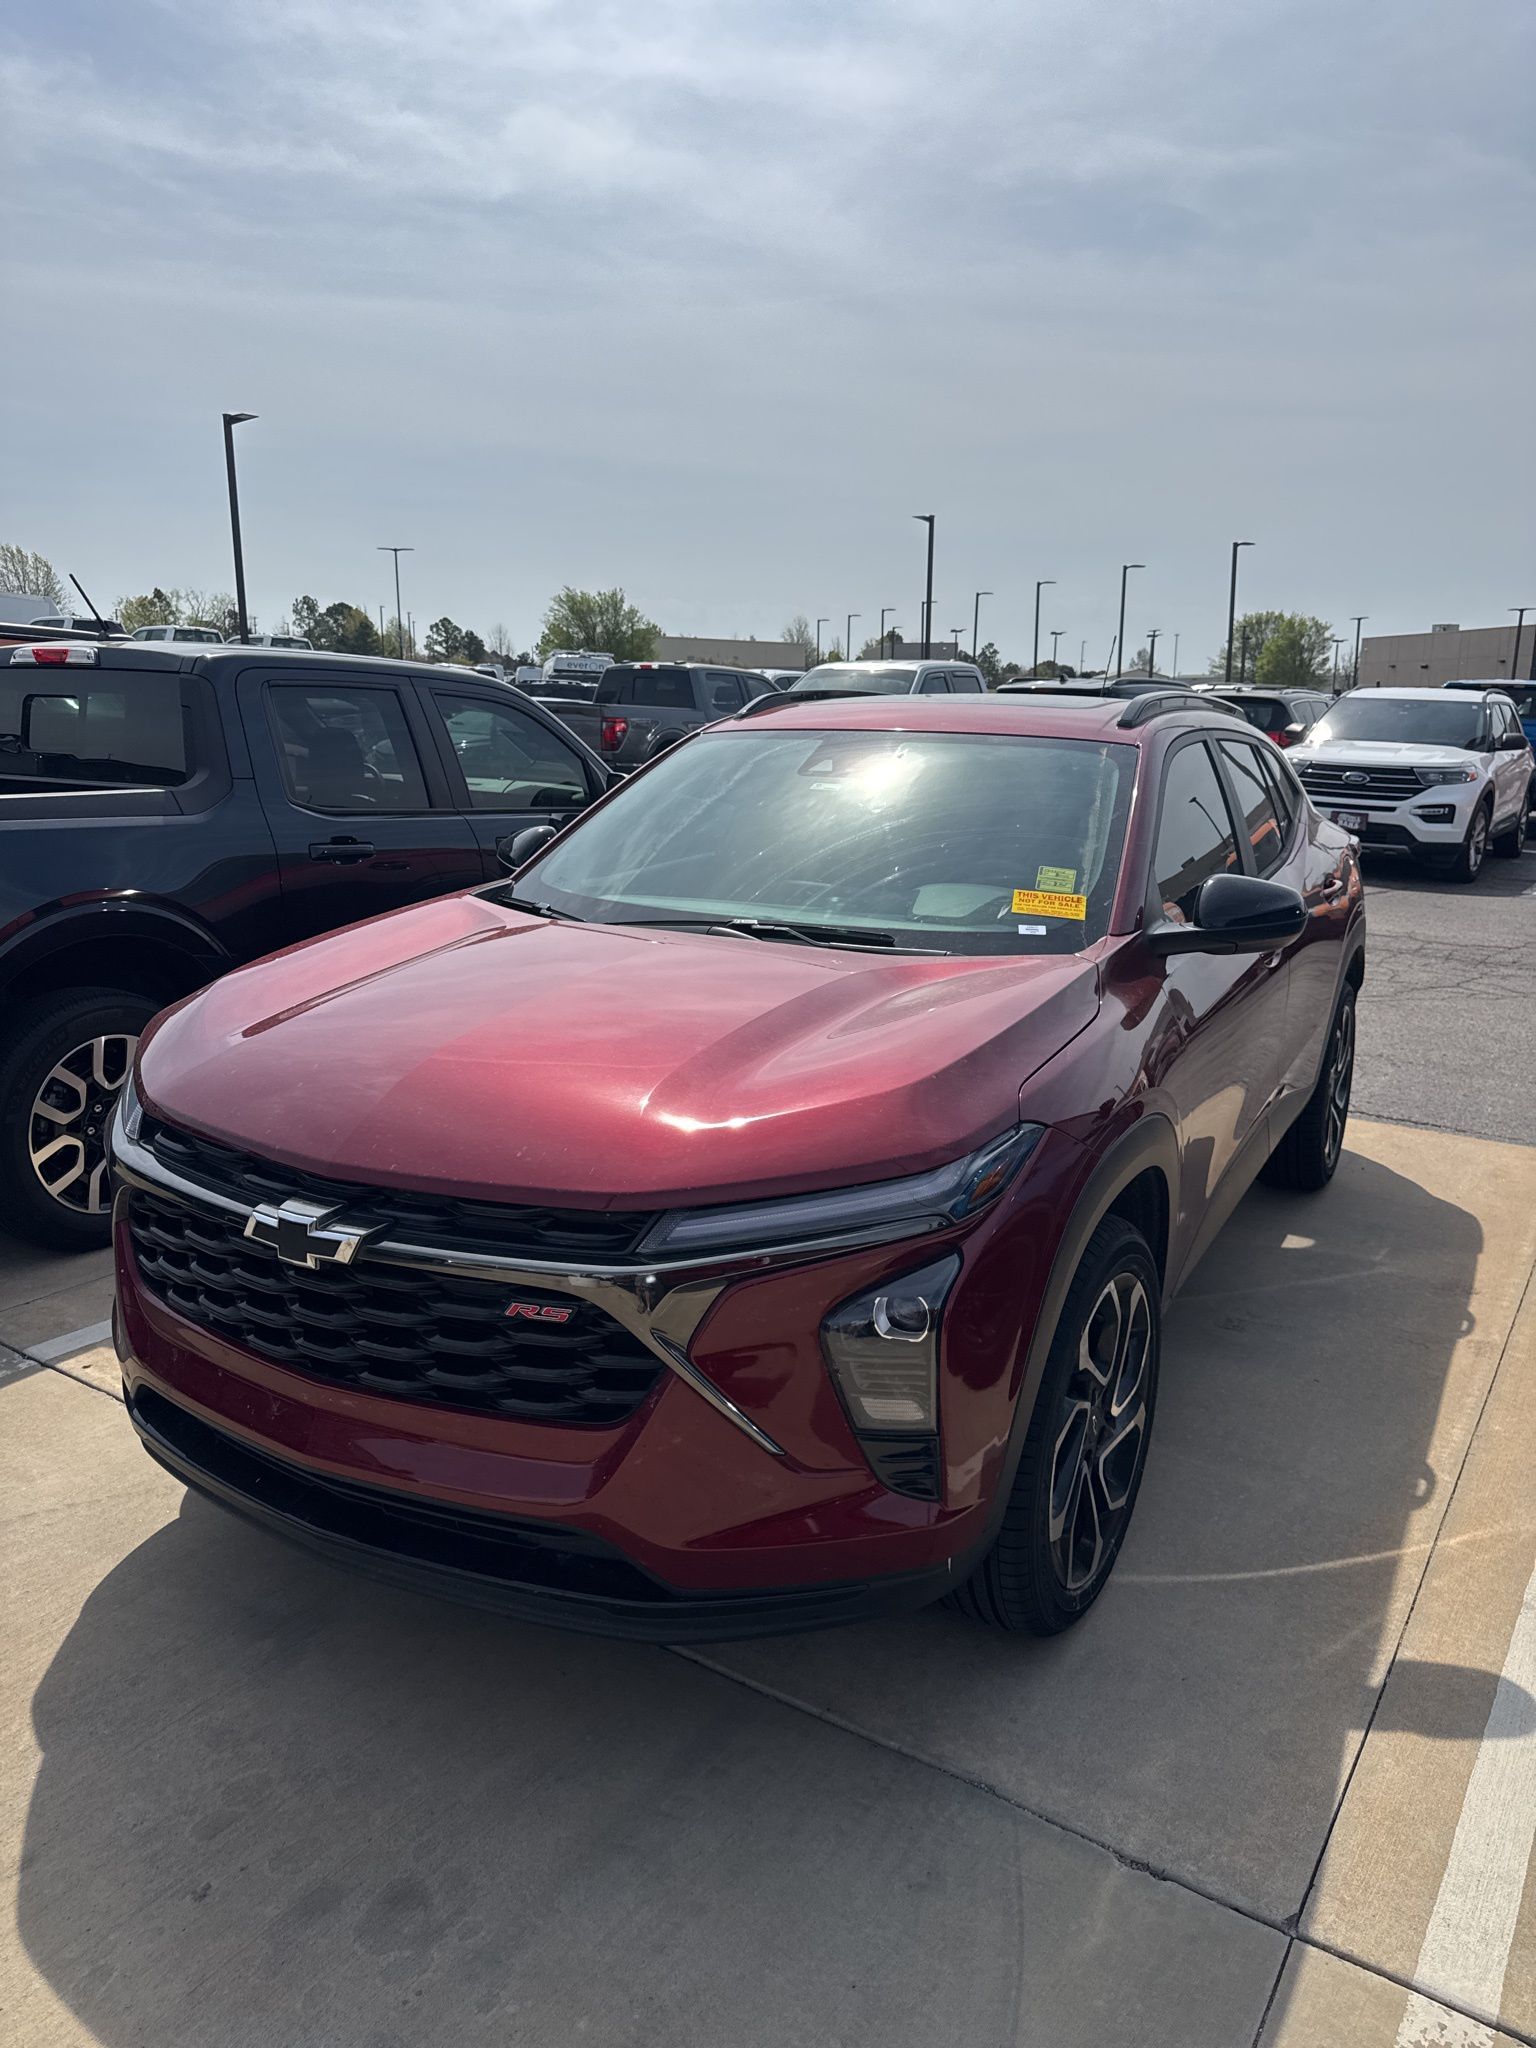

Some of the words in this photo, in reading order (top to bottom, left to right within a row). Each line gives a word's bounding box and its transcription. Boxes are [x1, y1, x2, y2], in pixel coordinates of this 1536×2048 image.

[1017, 891, 1039, 899] THIS
[1042, 893, 1083, 903] VEHICLE
[504, 1302, 573, 1323] RS
